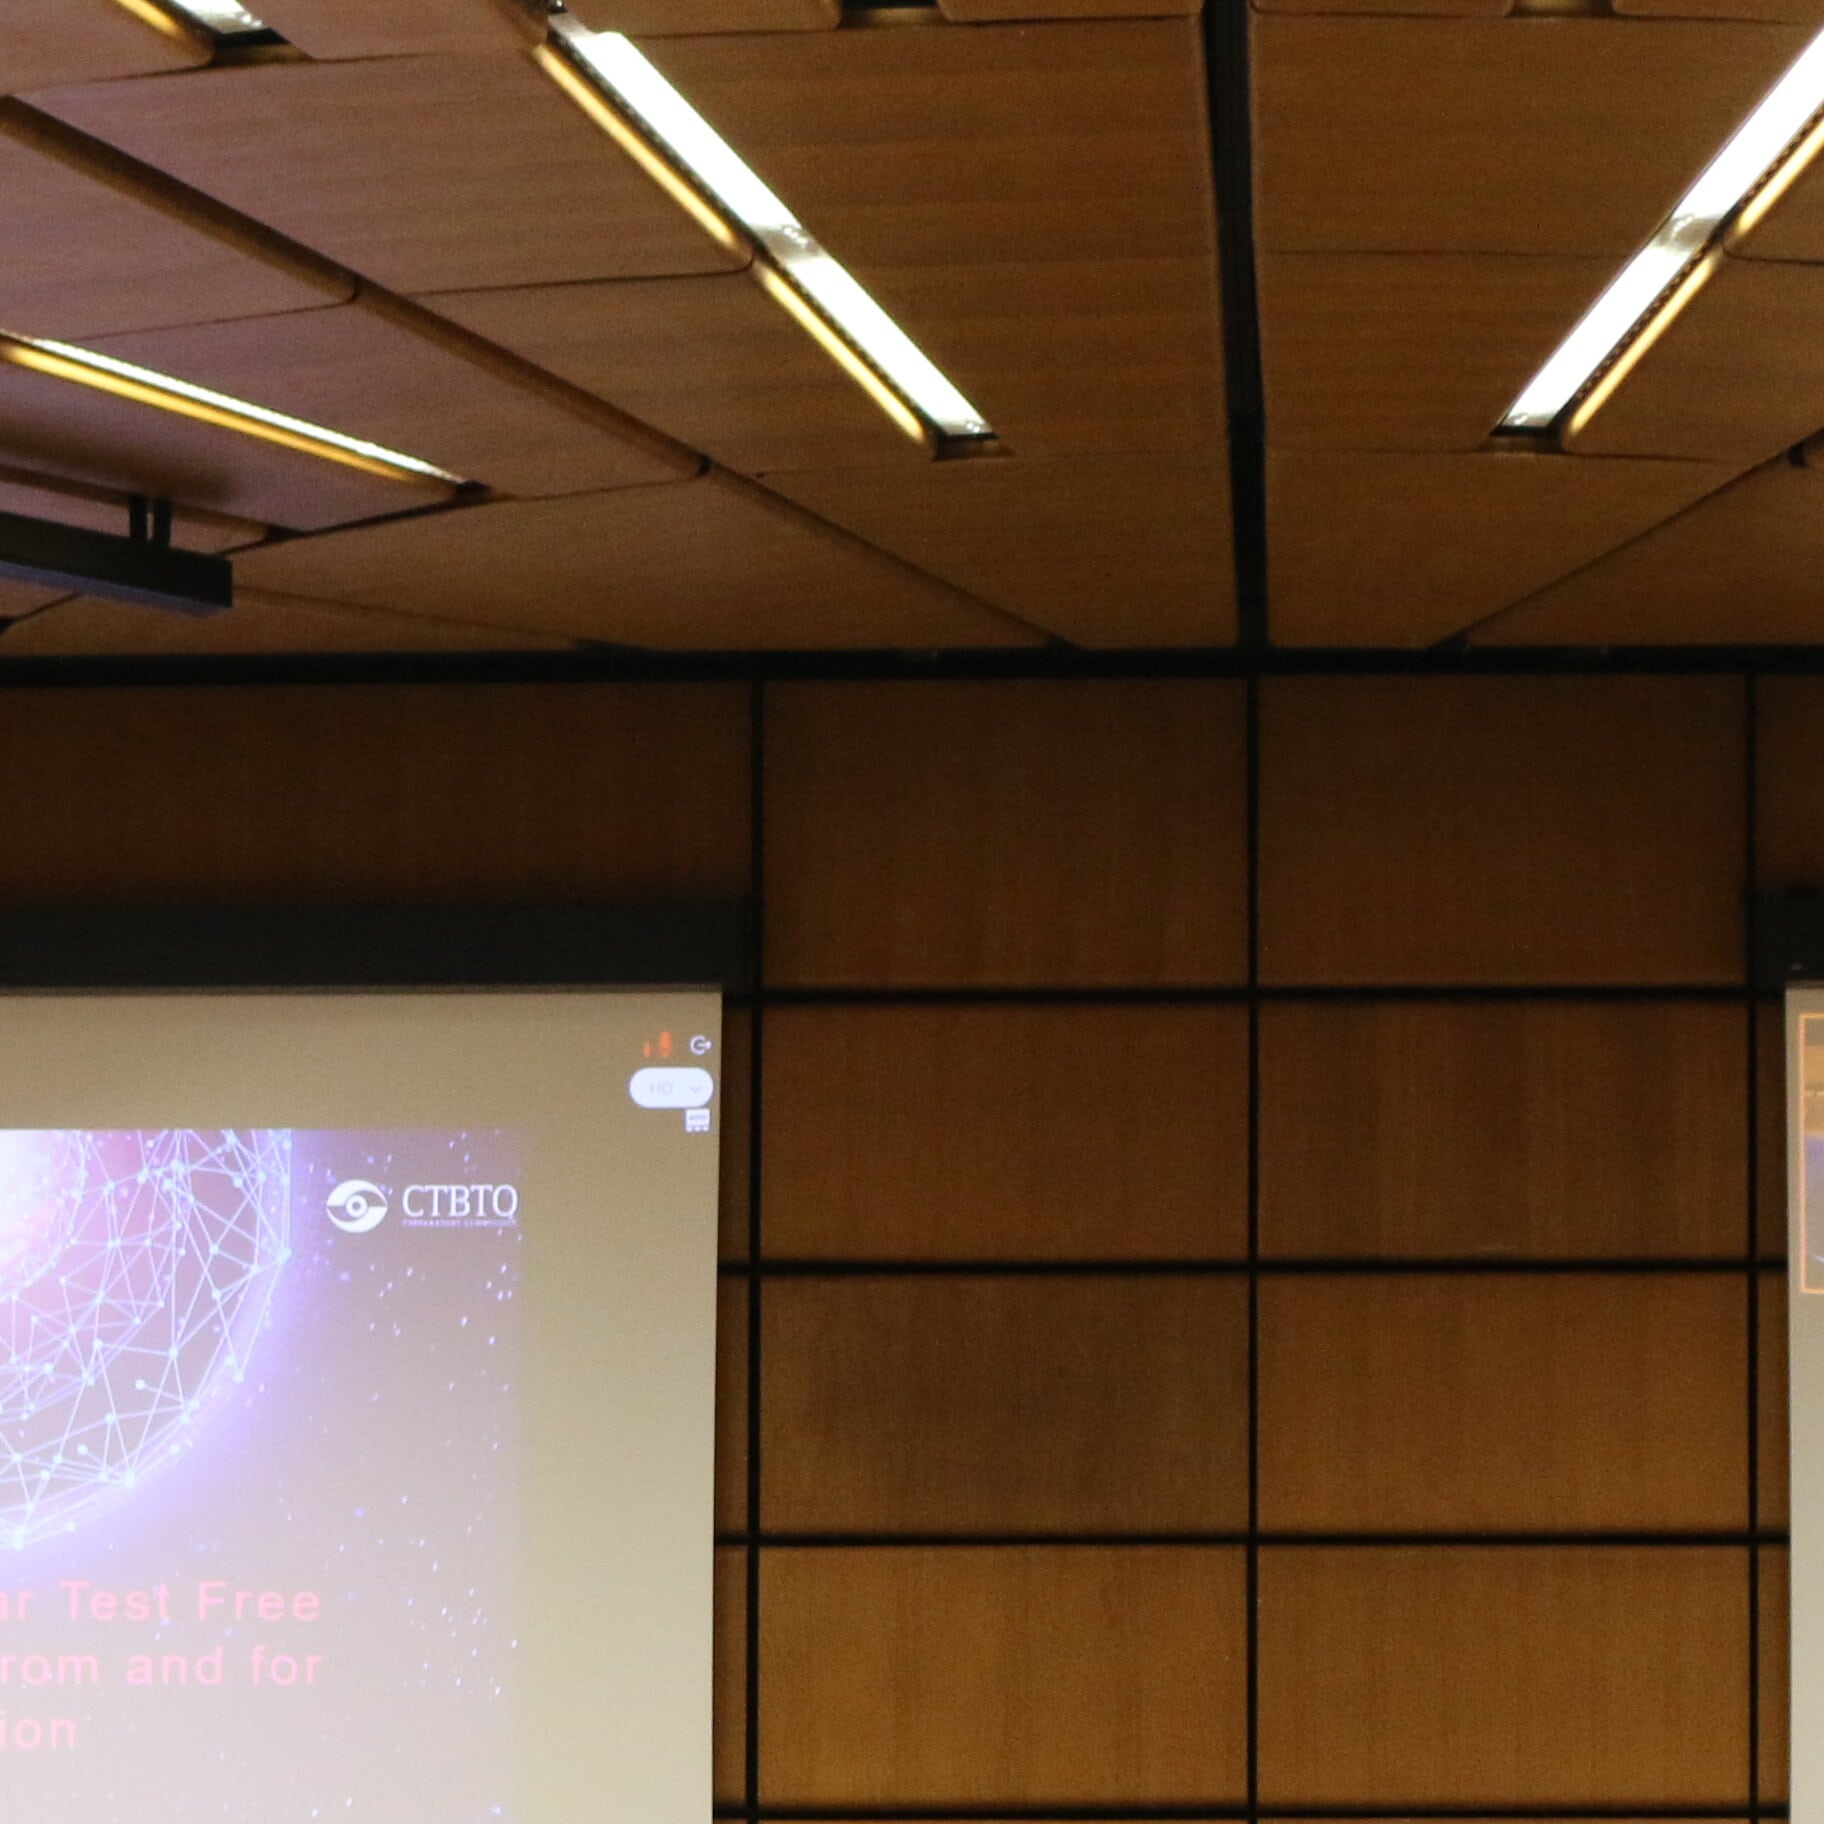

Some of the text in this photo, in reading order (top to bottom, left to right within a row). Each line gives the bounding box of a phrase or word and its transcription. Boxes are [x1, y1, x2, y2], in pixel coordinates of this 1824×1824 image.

[402, 1184, 518, 1217] CTBTO
[59, 1581, 171, 1622] Test
[197, 1581, 320, 1622] Free
[125, 1644, 224, 1687] and
[248, 1643, 326, 1687] for
